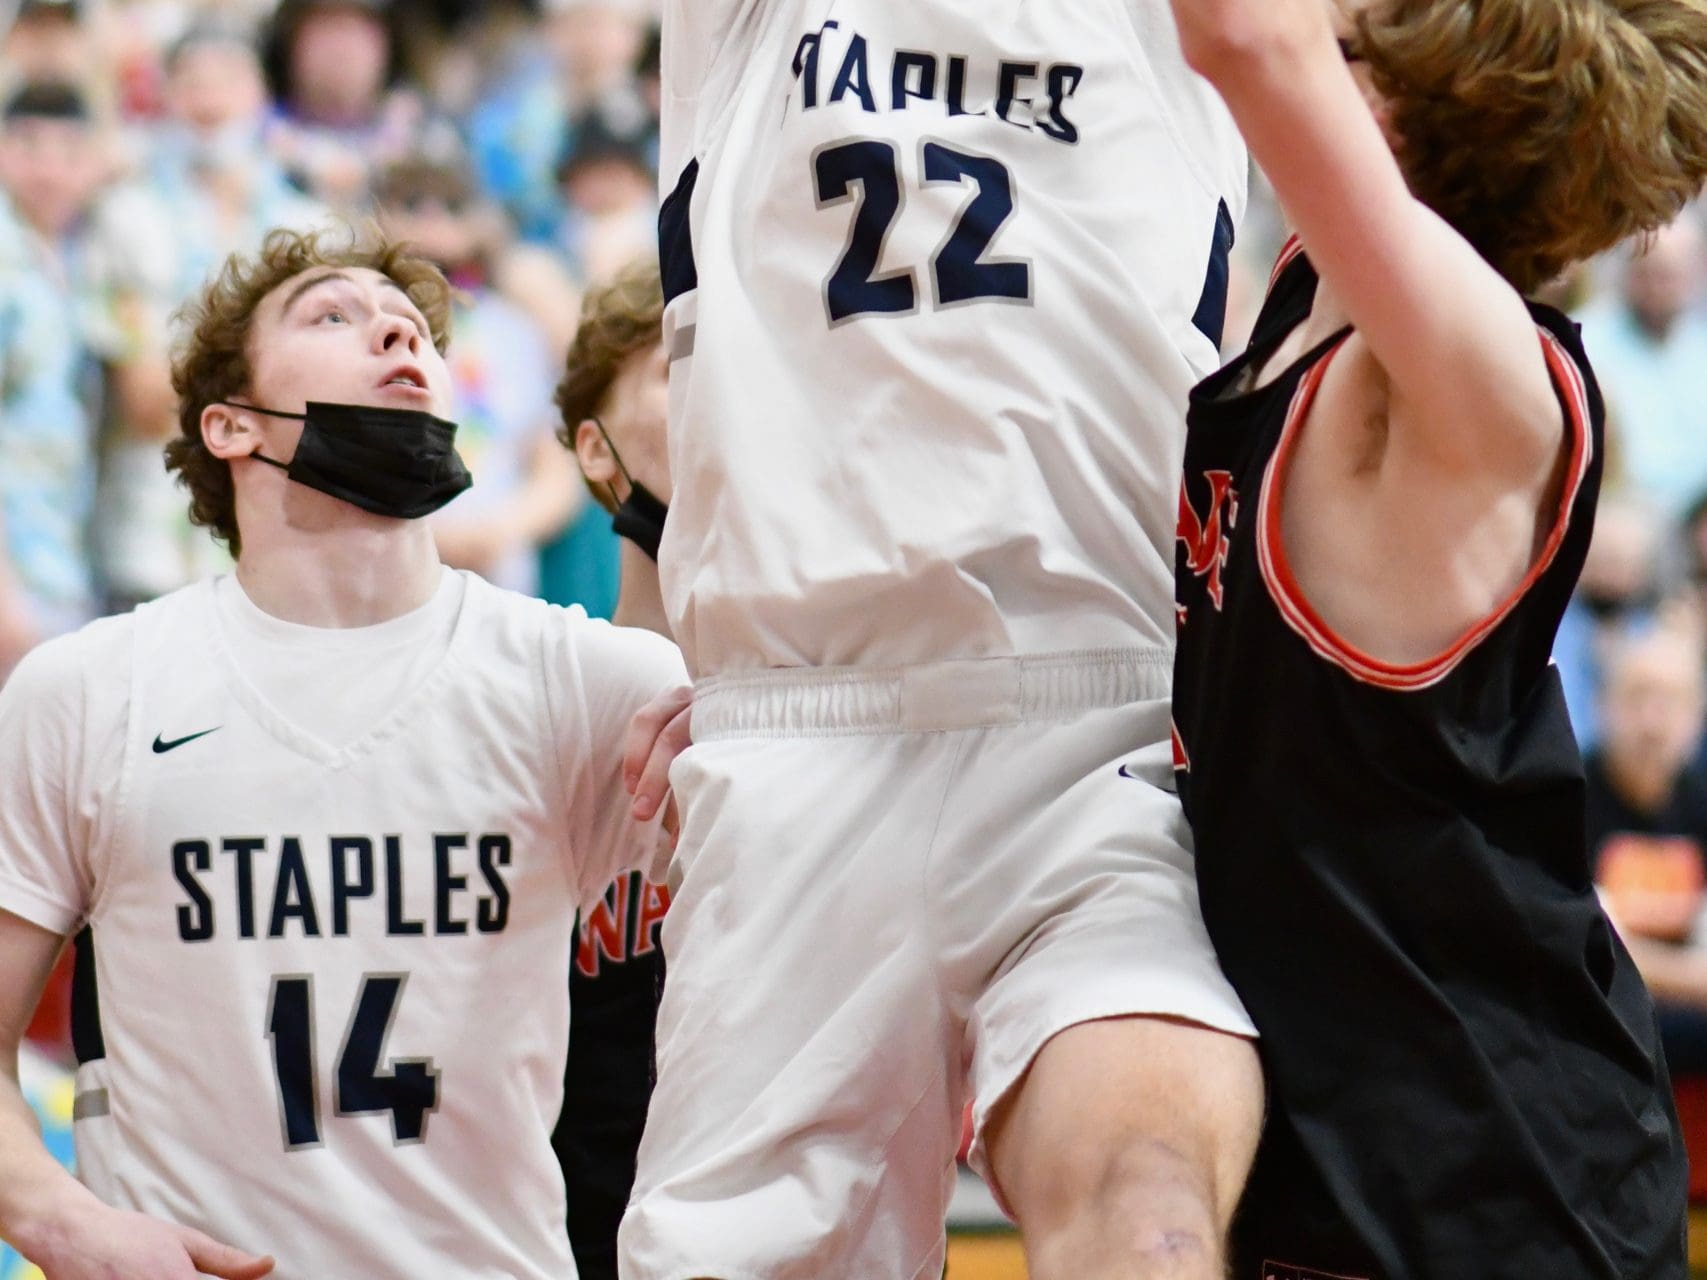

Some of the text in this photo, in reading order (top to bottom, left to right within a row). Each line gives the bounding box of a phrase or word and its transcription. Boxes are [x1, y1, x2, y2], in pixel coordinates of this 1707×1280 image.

[809, 134, 1035, 331] 22
[170, 831, 513, 944] STAPLES
[265, 971, 442, 1153] 14
